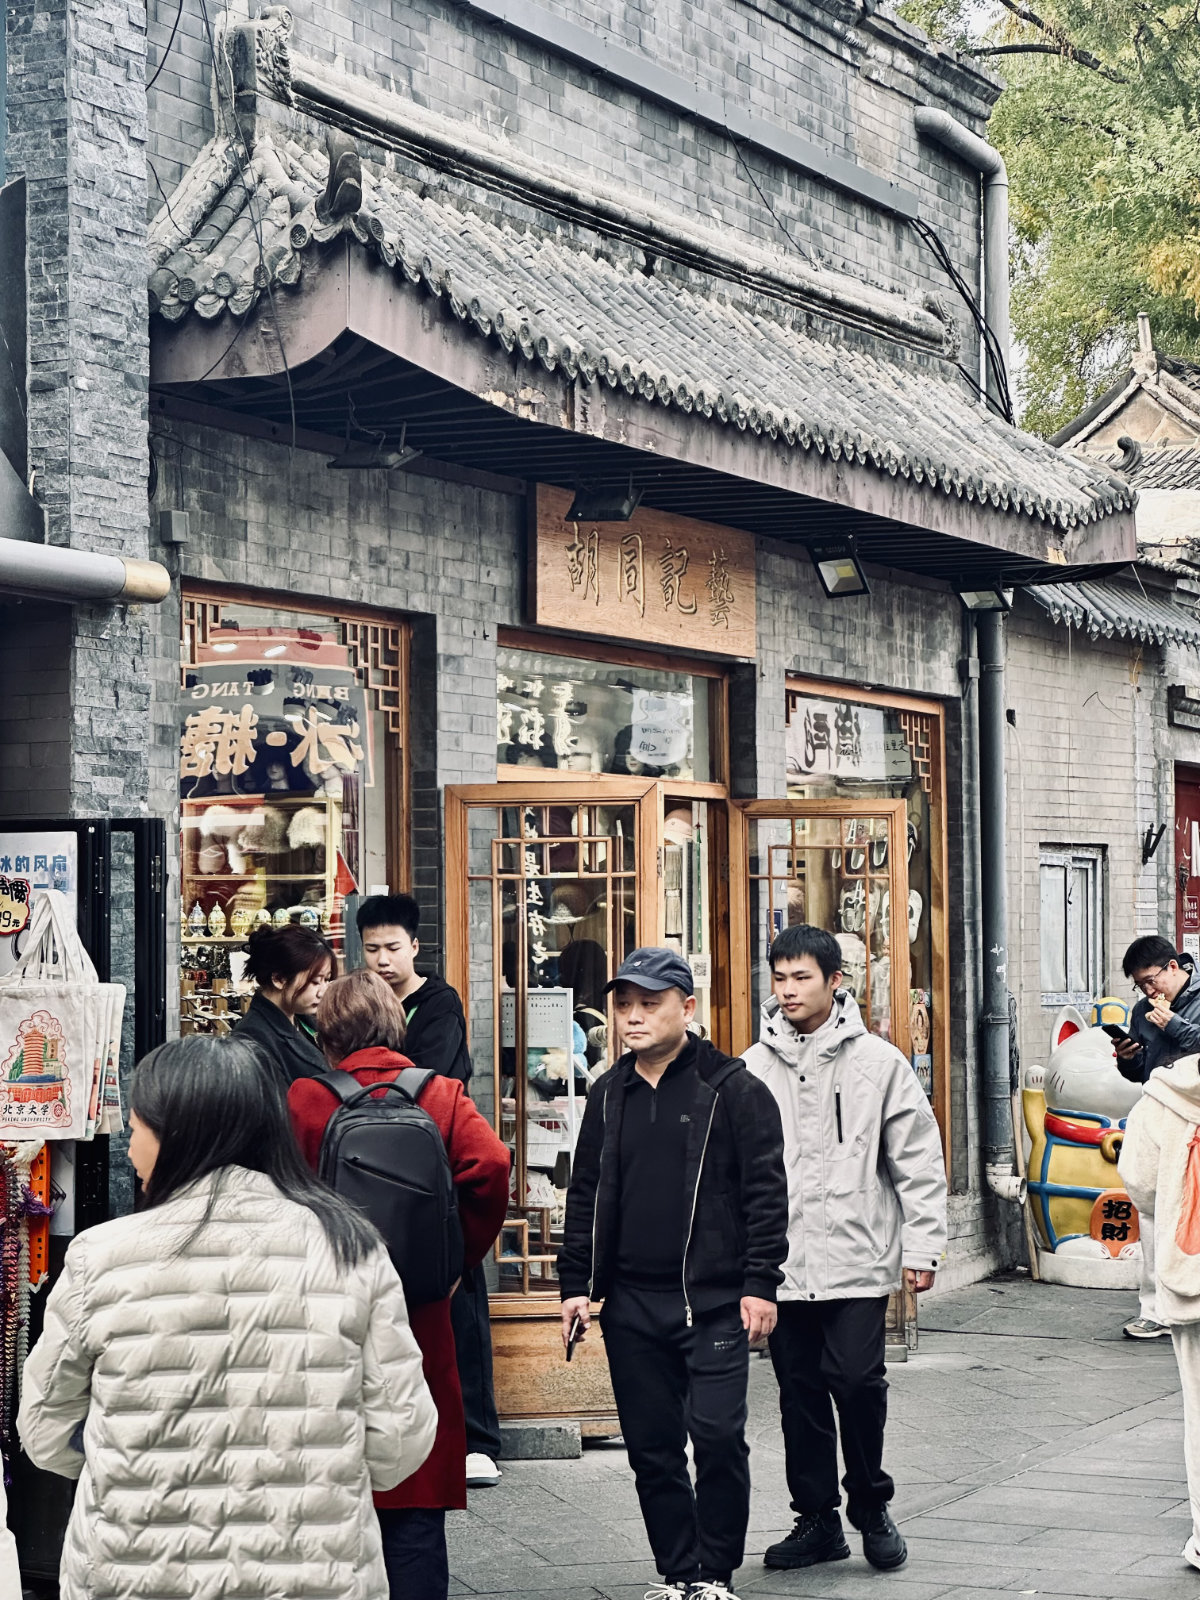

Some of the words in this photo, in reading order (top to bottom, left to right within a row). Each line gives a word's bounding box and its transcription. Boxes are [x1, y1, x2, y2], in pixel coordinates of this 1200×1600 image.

[2, 1104, 50, 1116] 北京大学
[1101, 1199, 1133, 1242] 招財
